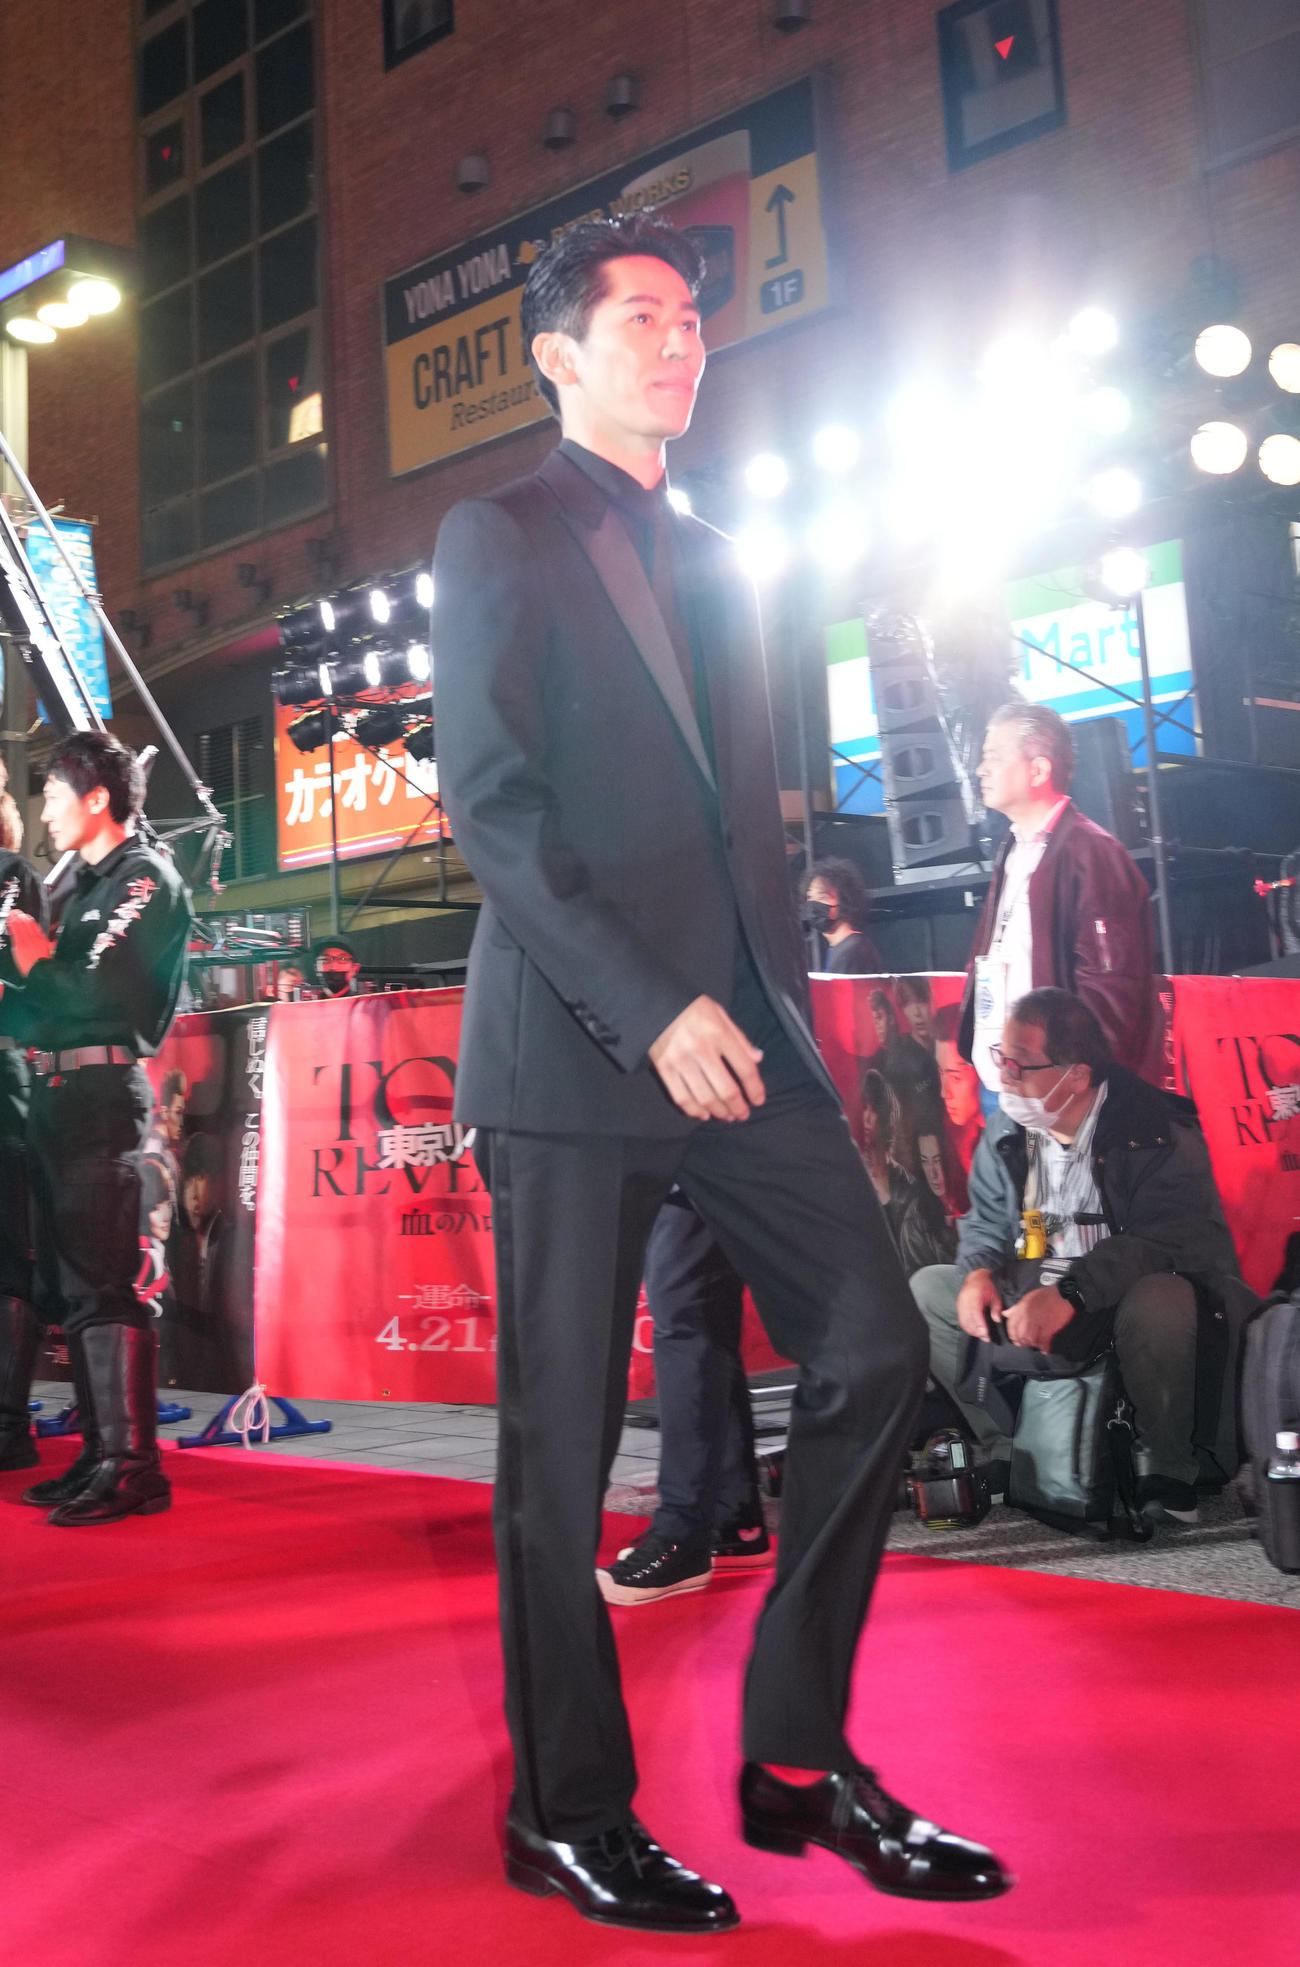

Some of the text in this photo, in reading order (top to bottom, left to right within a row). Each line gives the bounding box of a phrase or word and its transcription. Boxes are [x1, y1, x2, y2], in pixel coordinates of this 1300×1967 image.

[404, 270, 456, 324] YONA
[456, 243, 512, 299] YONA
[769, 277, 798, 306] 1F
[413, 316, 510, 410] CRAFT
[450, 379, 541, 431] Restaur
[1021, 610, 1141, 681] Mart
[375, 1315, 486, 1352] 4.21
